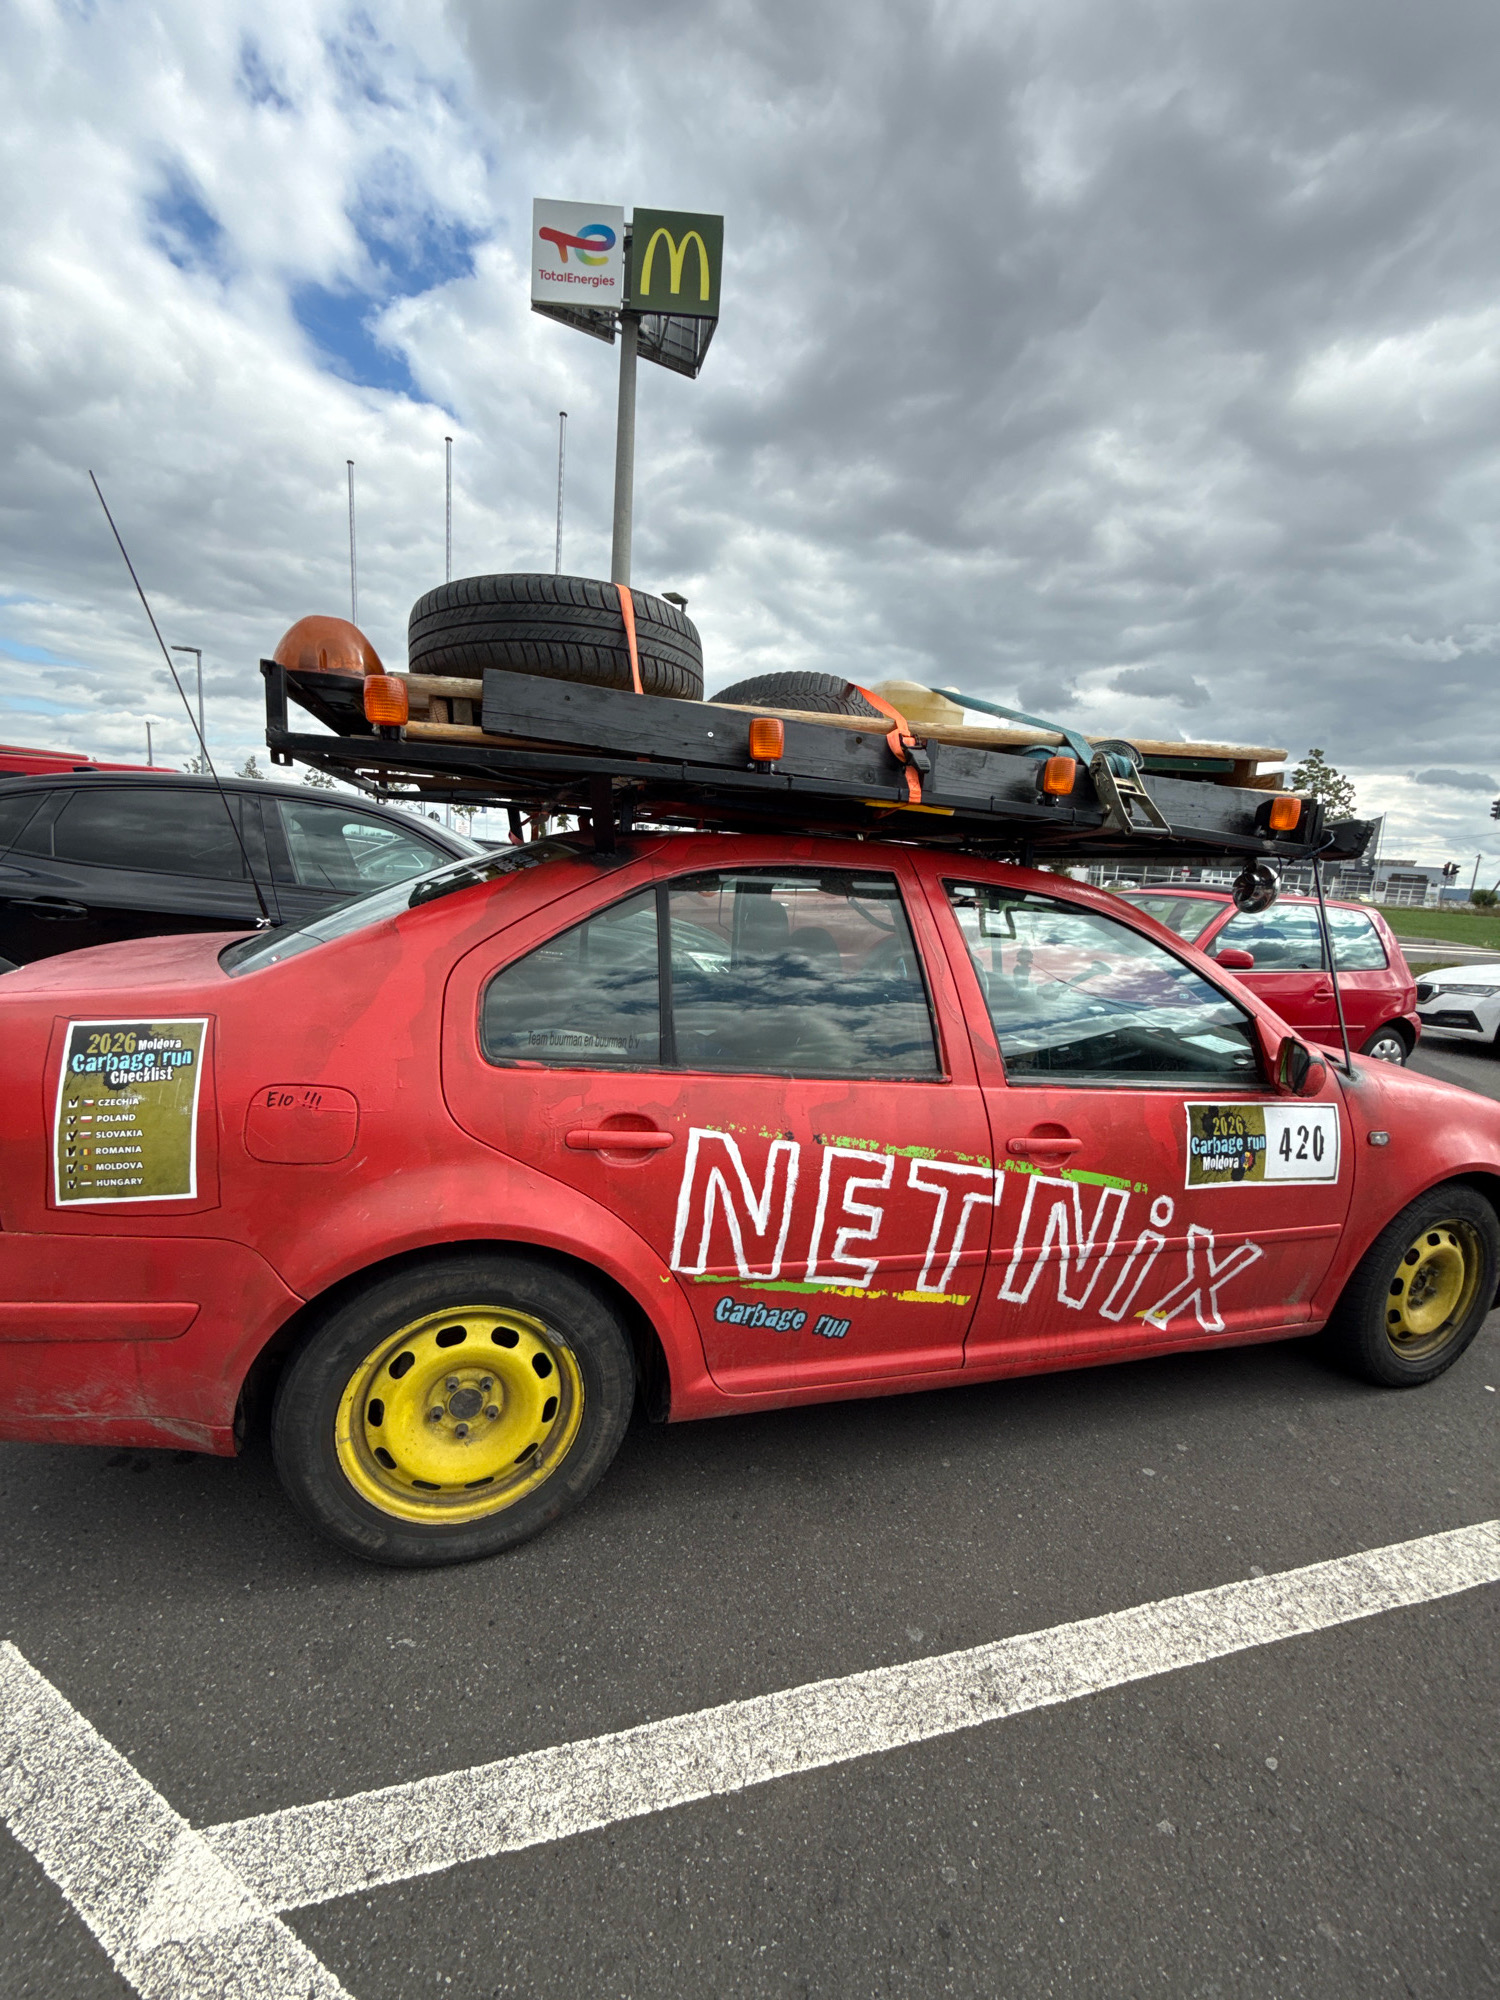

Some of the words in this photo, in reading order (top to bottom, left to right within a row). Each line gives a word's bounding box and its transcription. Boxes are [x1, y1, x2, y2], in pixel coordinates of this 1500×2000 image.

[538, 269, 615, 287] TotalEnergies
[87, 1032, 137, 1054] 2026
[138, 1038, 182, 1051] Moldova
[528, 1030, 549, 1046] Team
[549, 1032, 582, 1047] buurman
[583, 1035, 594, 1047] en
[595, 1034, 627, 1049] buurman
[72, 1052, 155, 1072] Carbage
[162, 1050, 192, 1066] run
[110, 1066, 173, 1084] Checklist
[98, 1098, 139, 1106] CZECHIA
[266, 1091, 294, 1107] E10
[96, 1113, 136, 1122] POLAND
[1212, 1116, 1244, 1135] 2026
[95, 1129, 143, 1138] SLOVAKIA
[95, 1145, 142, 1154] ROMANIA
[1191, 1136, 1243, 1155] Carbage
[1247, 1134, 1266, 1150] run
[1279, 1125, 1324, 1162] 420
[95, 1162, 143, 1170] MOLDOVA
[1202, 1154, 1239, 1171] Moldova
[96, 1177, 143, 1187] HUNGARY
[716, 1297, 806, 1331] Carbage
[814, 1315, 850, 1337] run
